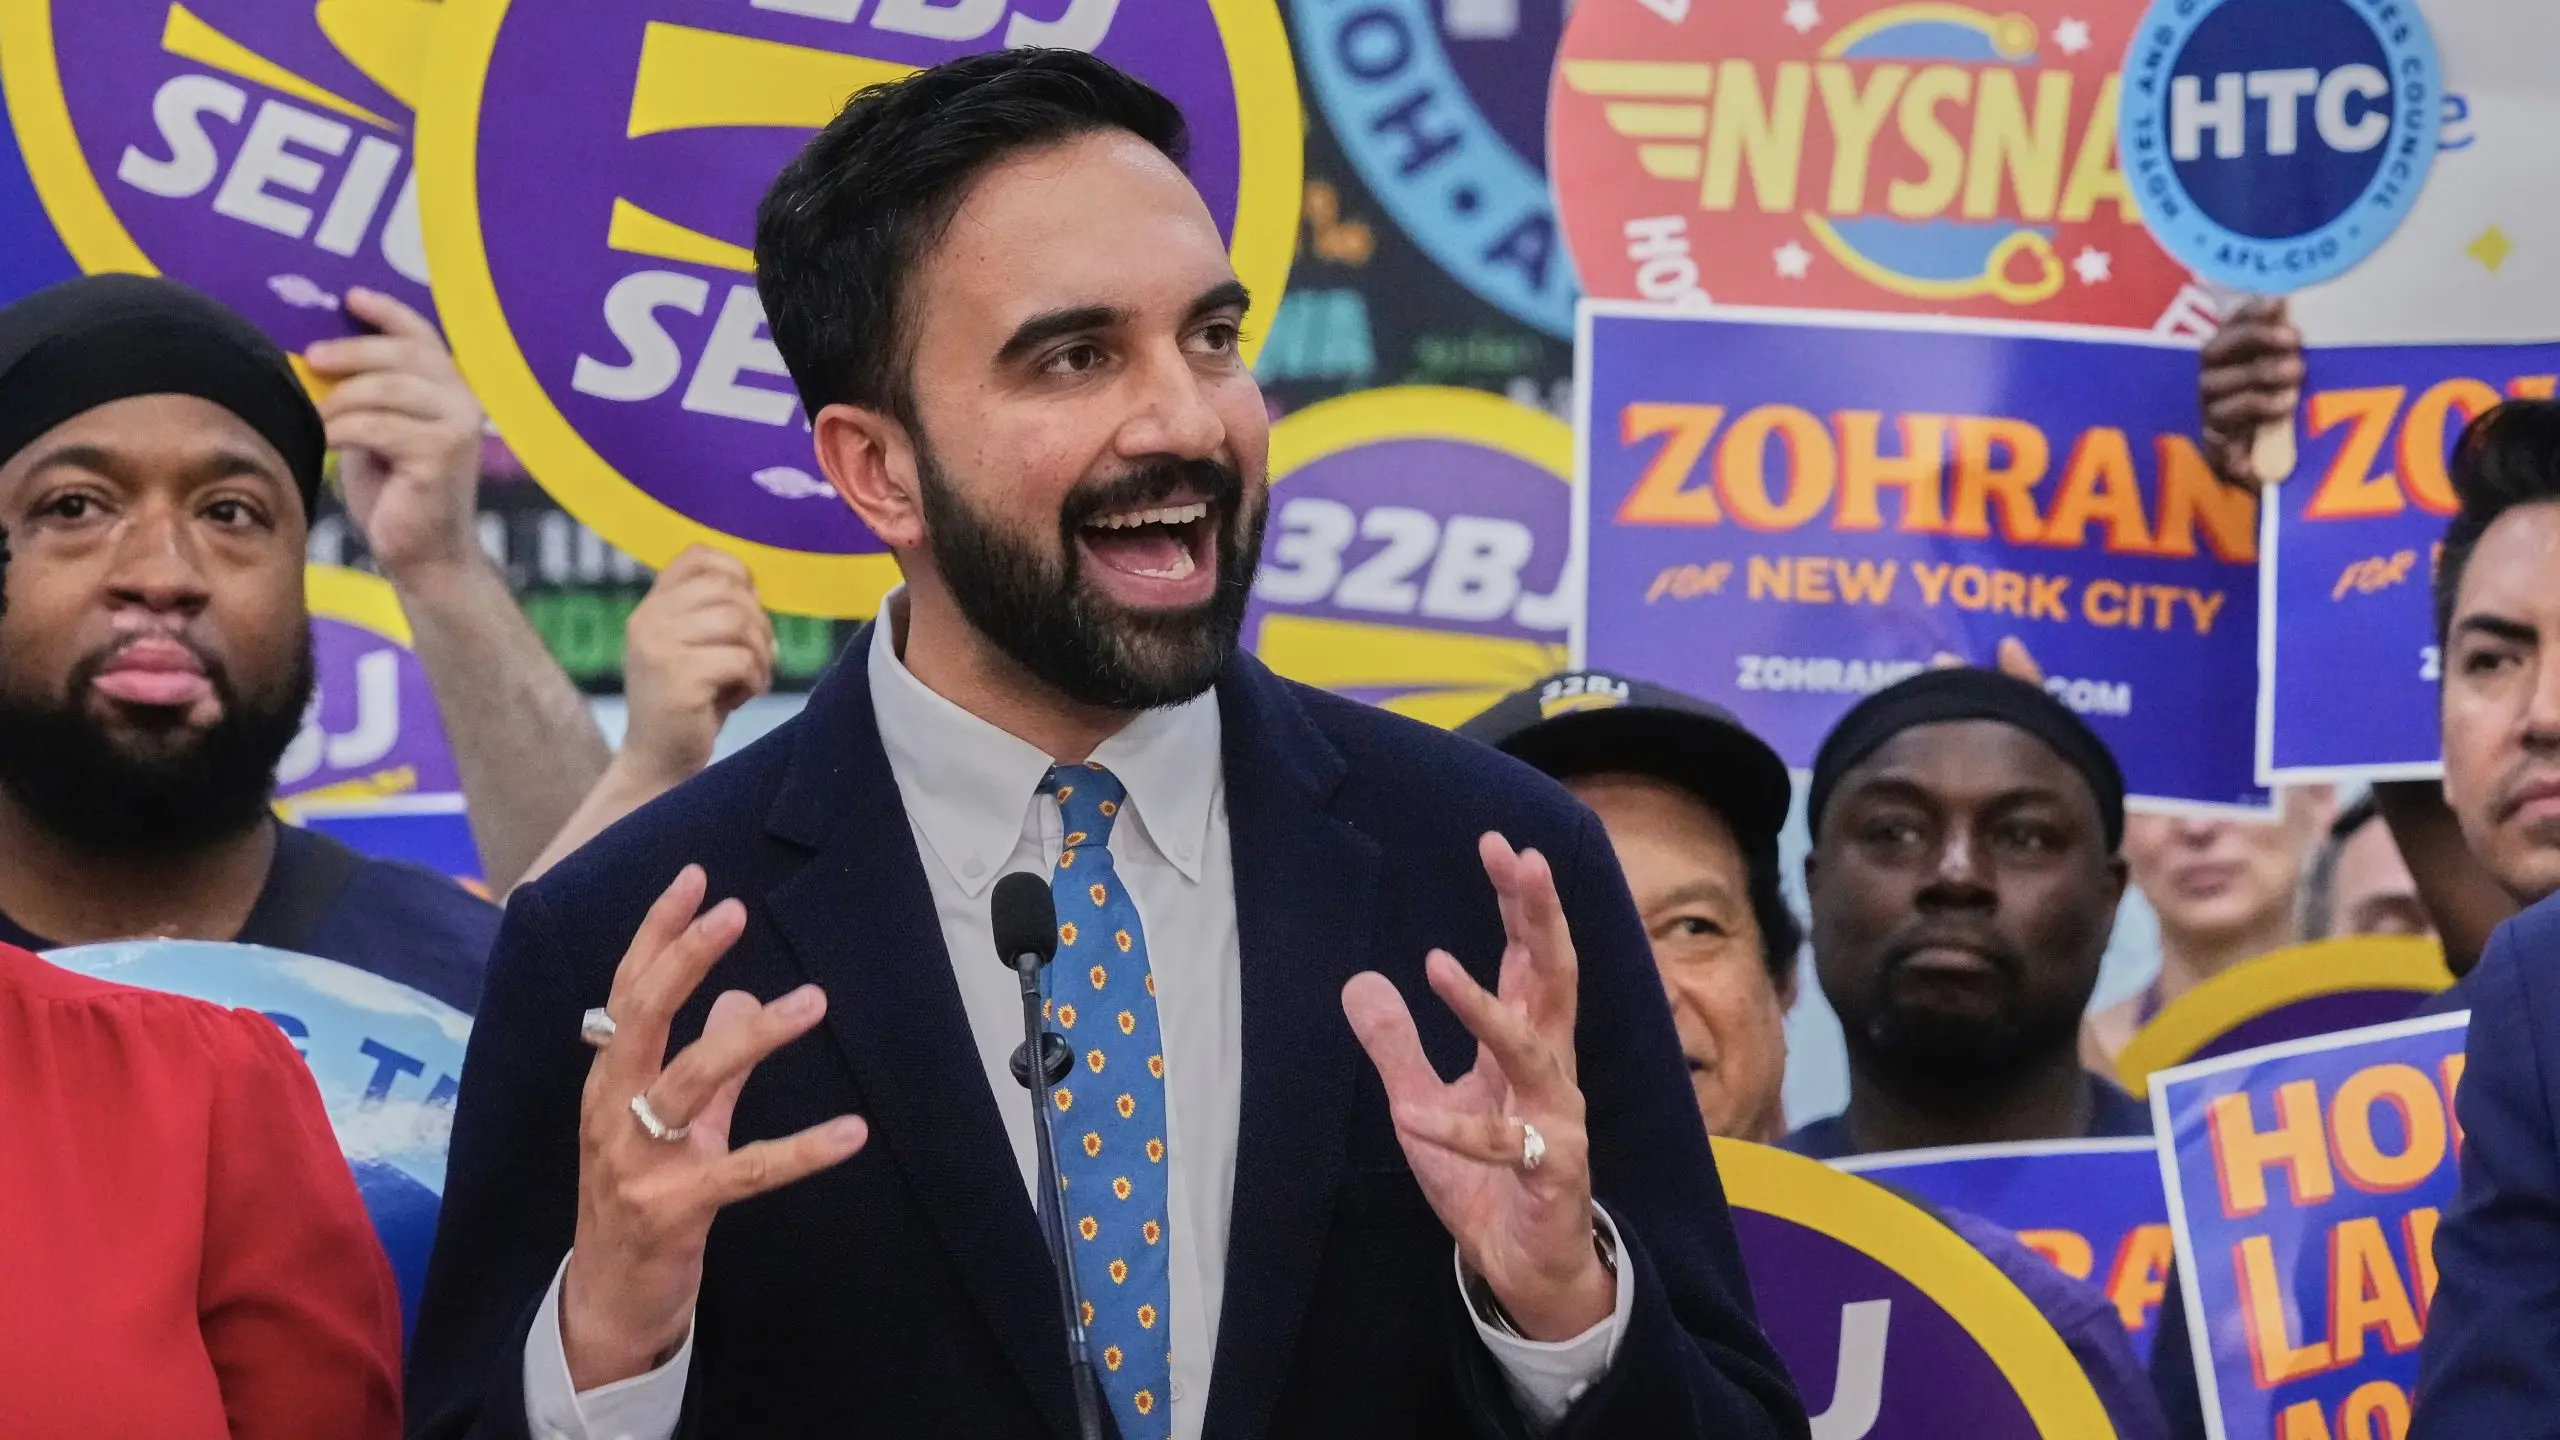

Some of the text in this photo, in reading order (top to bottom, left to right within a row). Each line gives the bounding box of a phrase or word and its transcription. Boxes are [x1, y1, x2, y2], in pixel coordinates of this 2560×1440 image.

[1700, 58, 2143, 223] NYSNA
[2169, 63, 2390, 162] HTC
[2214, 236, 2341, 274] AFL-CIO
[571, 269, 812, 432] SE
[1613, 403, 2257, 563] ZOHRAN
[2303, 375, 2557, 520] ZO
[1254, 497, 1573, 631] 32BJ
[1645, 554, 2226, 637] FOR NEW YORK CITY
[1539, 674, 1629, 704] 32BJ
[2207, 1051, 2466, 1219] HO
